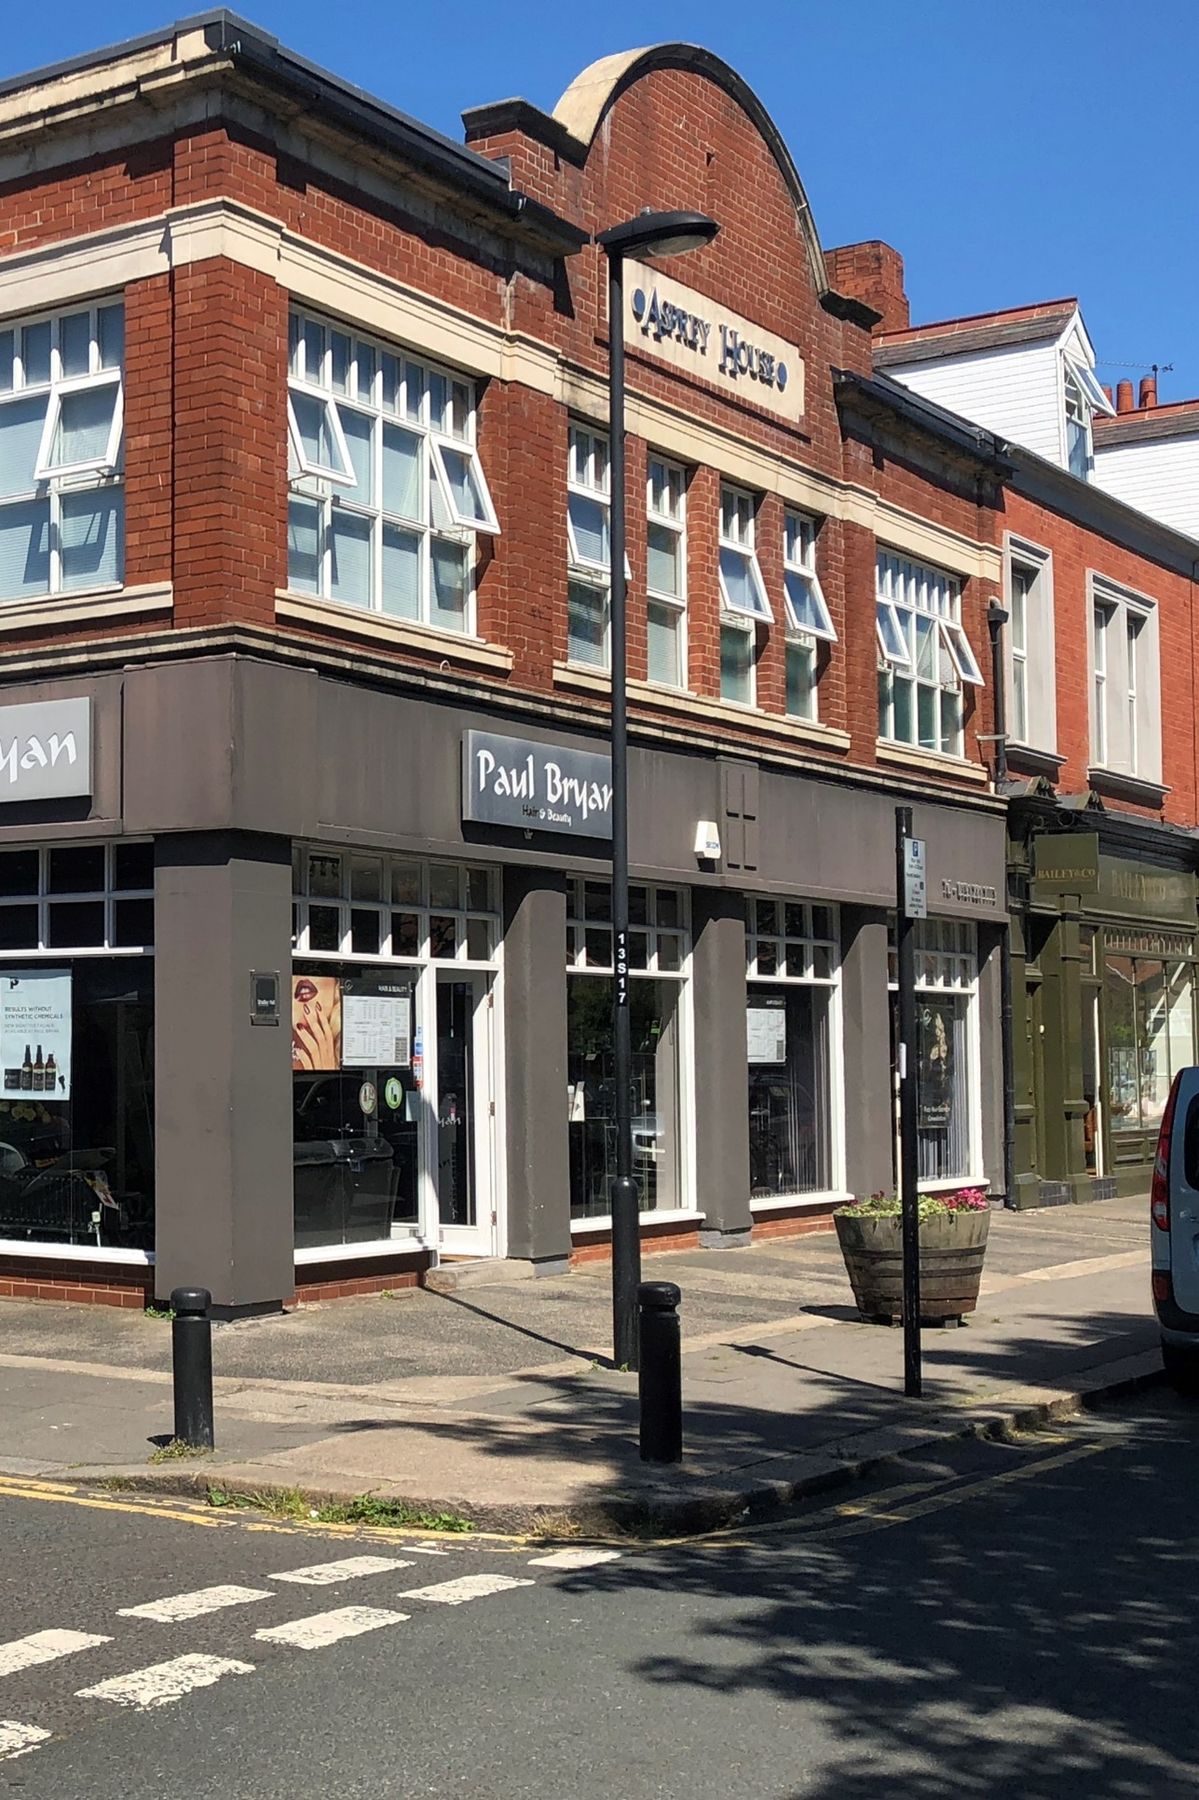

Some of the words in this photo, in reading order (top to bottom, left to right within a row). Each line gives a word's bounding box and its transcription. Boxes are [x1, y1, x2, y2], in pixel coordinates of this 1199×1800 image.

[718, 324, 776, 387] HOUSE
[476, 749, 535, 800] Paul
[522, 804, 540, 818] Hair
[539, 808, 546, 820] &
[547, 808, 572, 827] Beauty
[617, 932, 627, 1004] 13S17
